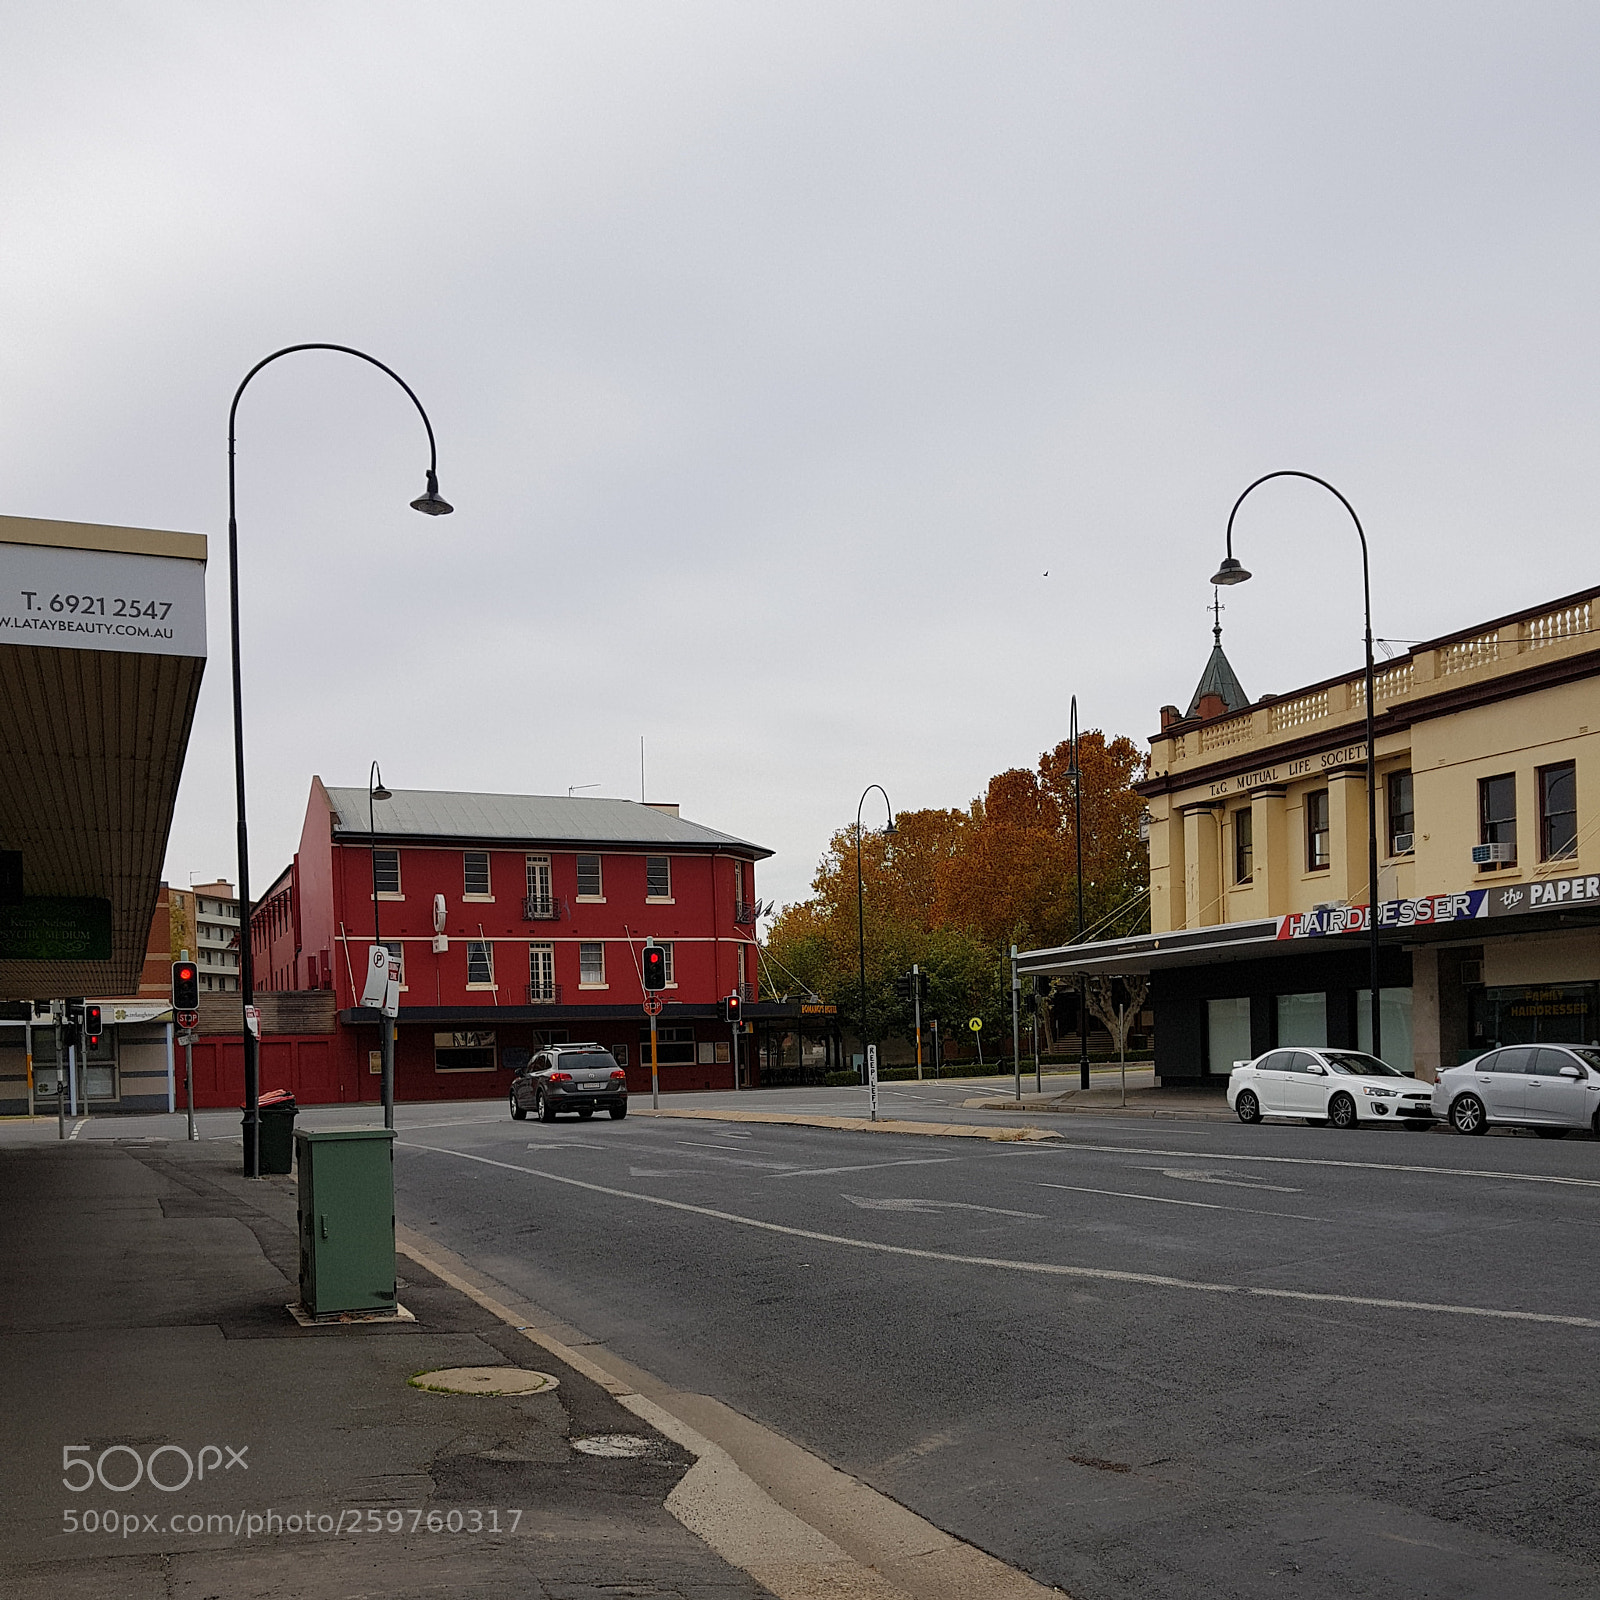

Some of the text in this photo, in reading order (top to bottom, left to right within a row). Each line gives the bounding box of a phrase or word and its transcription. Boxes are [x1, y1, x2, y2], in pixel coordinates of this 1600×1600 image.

[21, 591, 173, 620] T. 6921 2547
[1236, 768, 1279, 790] MUTUAL
[1288, 759, 1311, 776] LIFE
[1320, 743, 1369, 768] SOCIETY
[1500, 877, 1600, 905] the PAPER
[1525, 989, 1565, 1002] FAMILY
[179, 1014, 198, 1022] STOP
[1510, 1002, 1589, 1017] HAIRDRESSER
